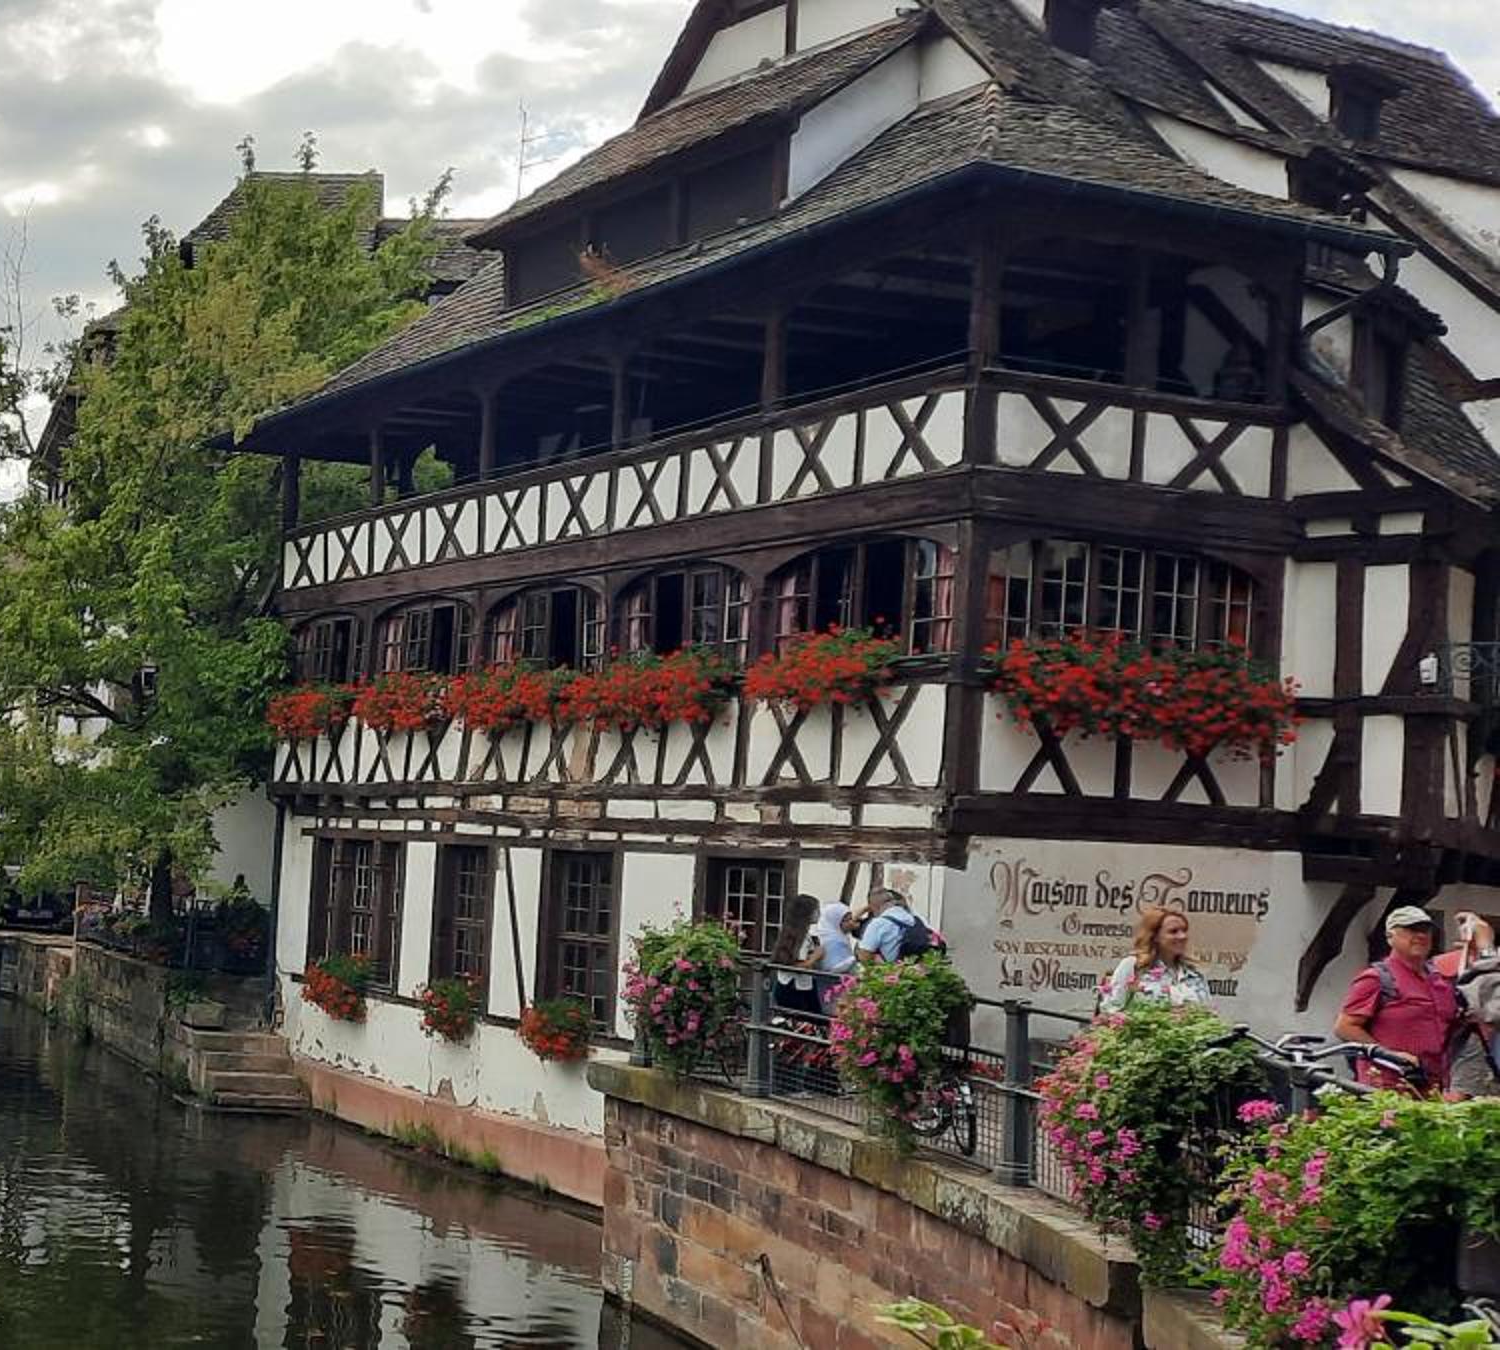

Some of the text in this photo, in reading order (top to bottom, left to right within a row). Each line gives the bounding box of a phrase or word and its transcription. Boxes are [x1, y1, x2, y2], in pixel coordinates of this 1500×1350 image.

[990, 858, 1271, 921] Maison des Tanneurs
[993, 938, 1021, 954] SON
[1023, 941, 1106, 959] RESTAURANT
[999, 955, 1023, 989] La
[1029, 957, 1097, 993] Maison
